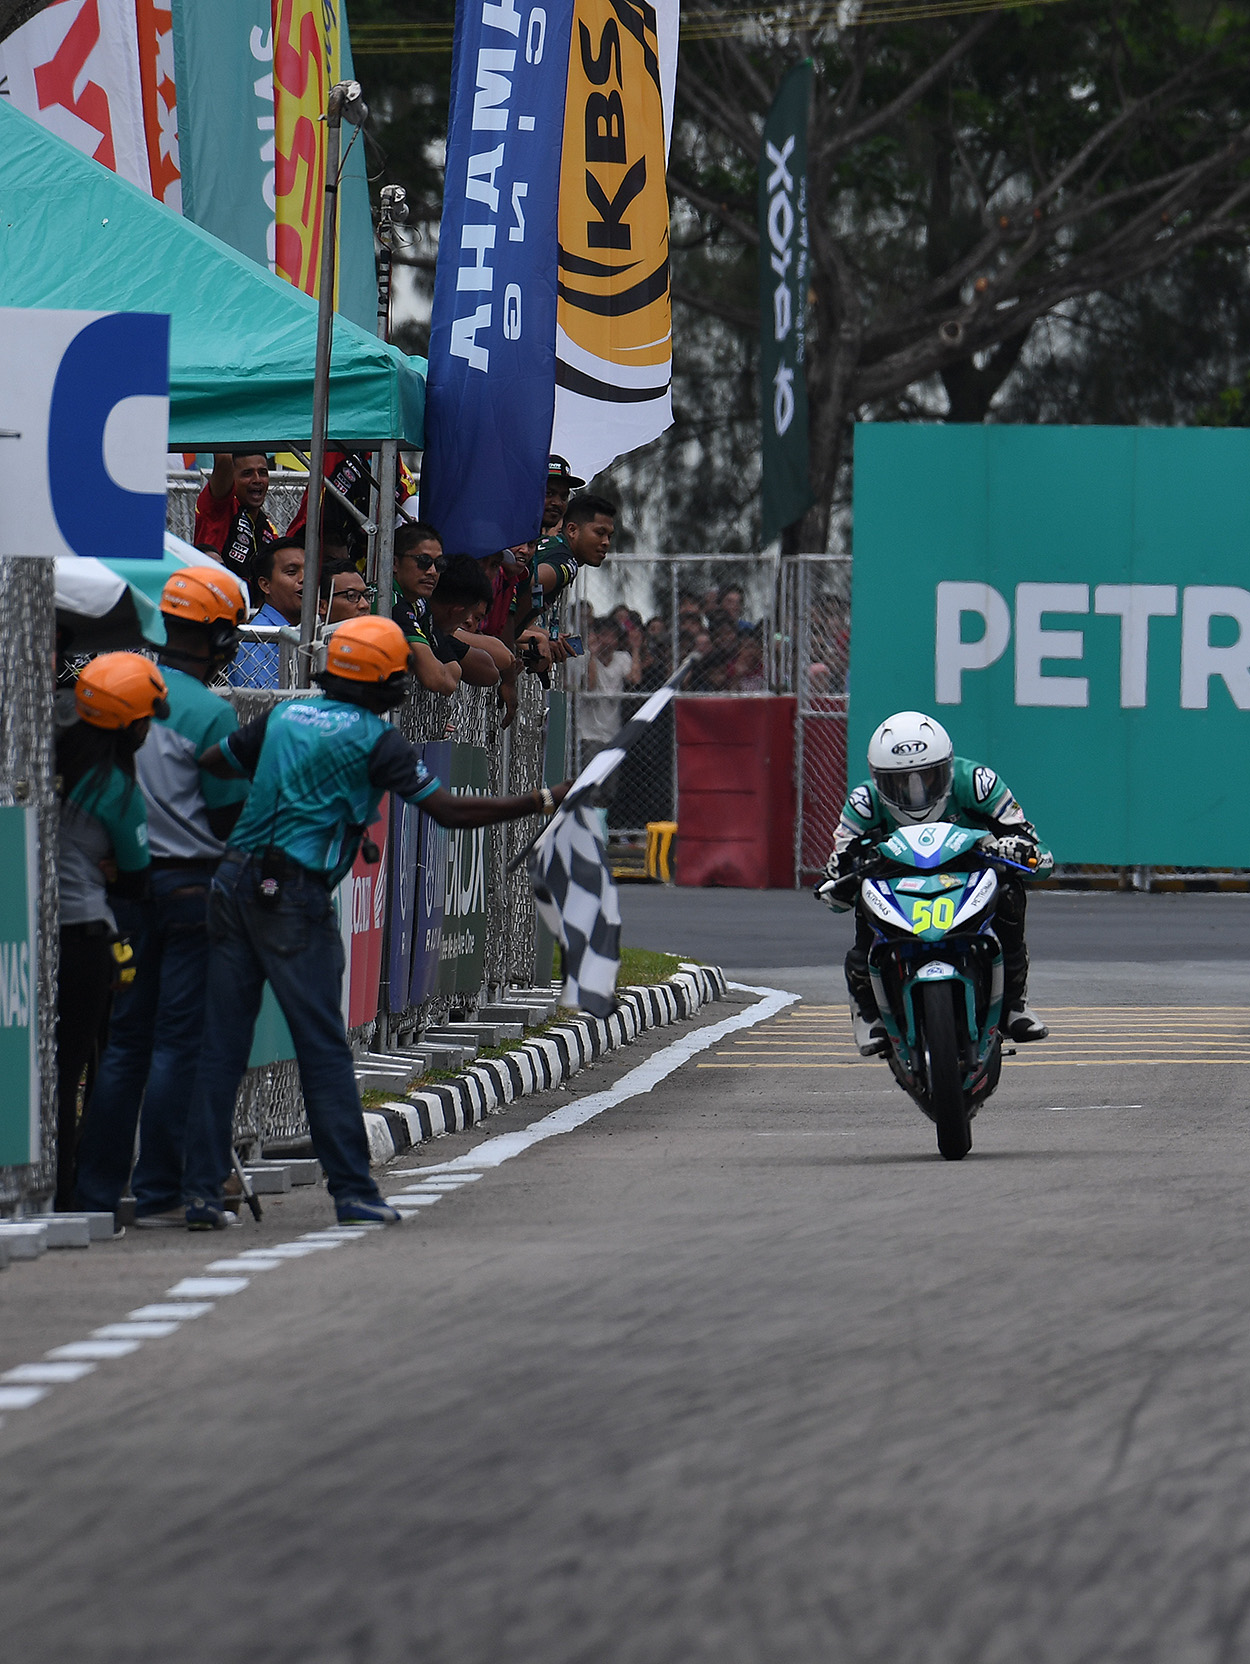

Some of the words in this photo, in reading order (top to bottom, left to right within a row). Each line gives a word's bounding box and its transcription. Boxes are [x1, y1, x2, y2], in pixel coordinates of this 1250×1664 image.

[577, 16, 648, 250] KBS
[895, 741, 924, 755] KYT
[866, 889, 891, 916] PETRONAS
[912, 897, 955, 935] 50
